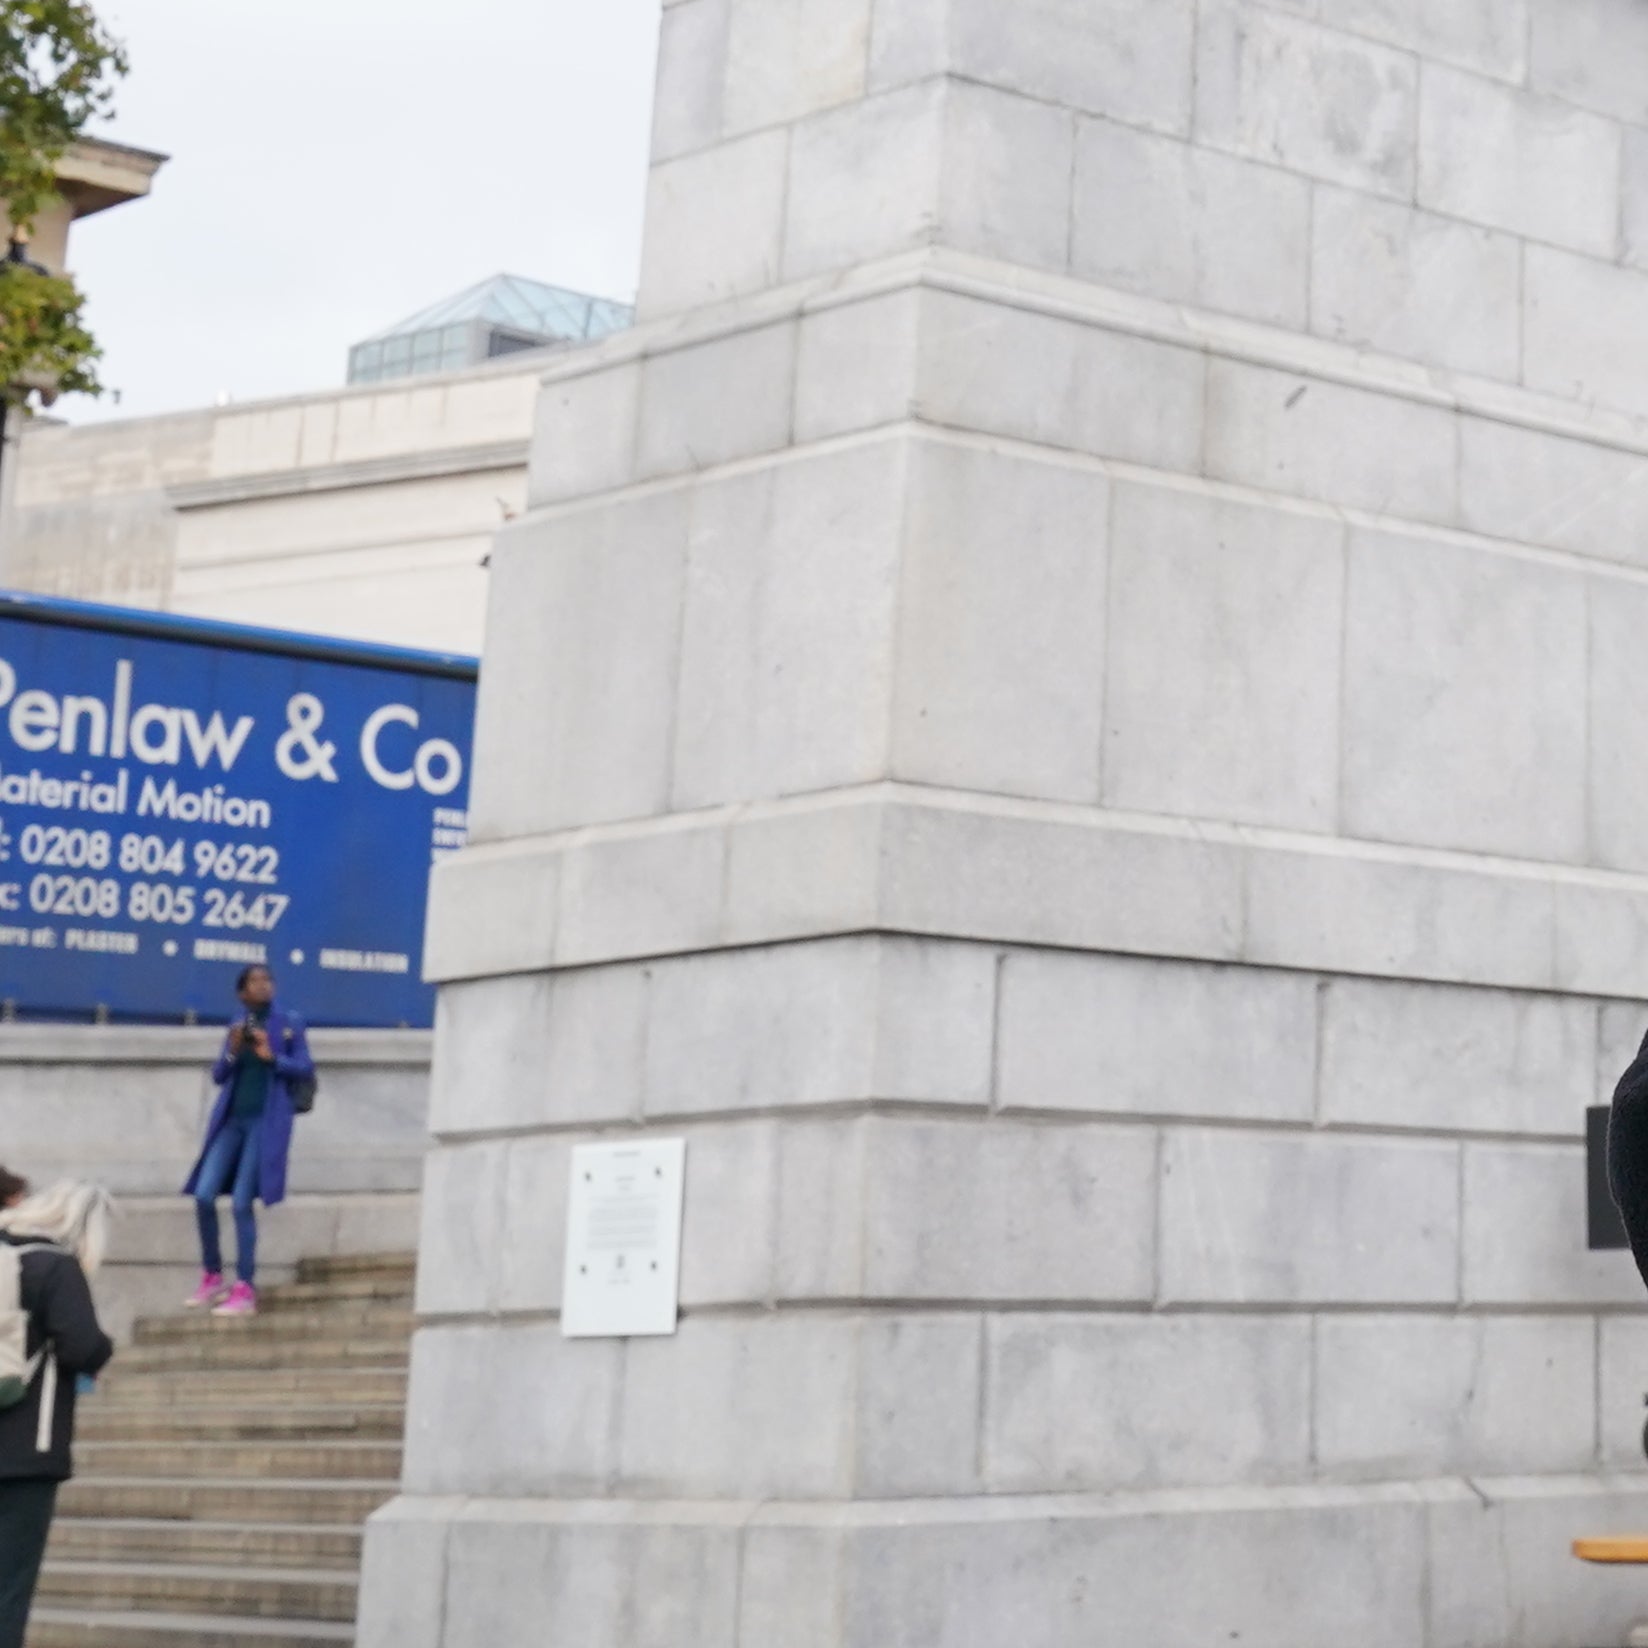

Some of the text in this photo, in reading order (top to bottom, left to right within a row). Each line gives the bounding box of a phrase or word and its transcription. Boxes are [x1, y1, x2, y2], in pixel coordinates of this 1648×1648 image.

[276, 692, 338, 782] &
[360, 703, 463, 796] Co
[0, 768, 271, 829] aterial Motion
[19, 824, 111, 870] 0208
[118, 833, 186, 876] 804
[193, 840, 279, 884] 9622
[29, 873, 120, 918] 0208
[127, 881, 195, 925] 805
[202, 888, 289, 930] 2647
